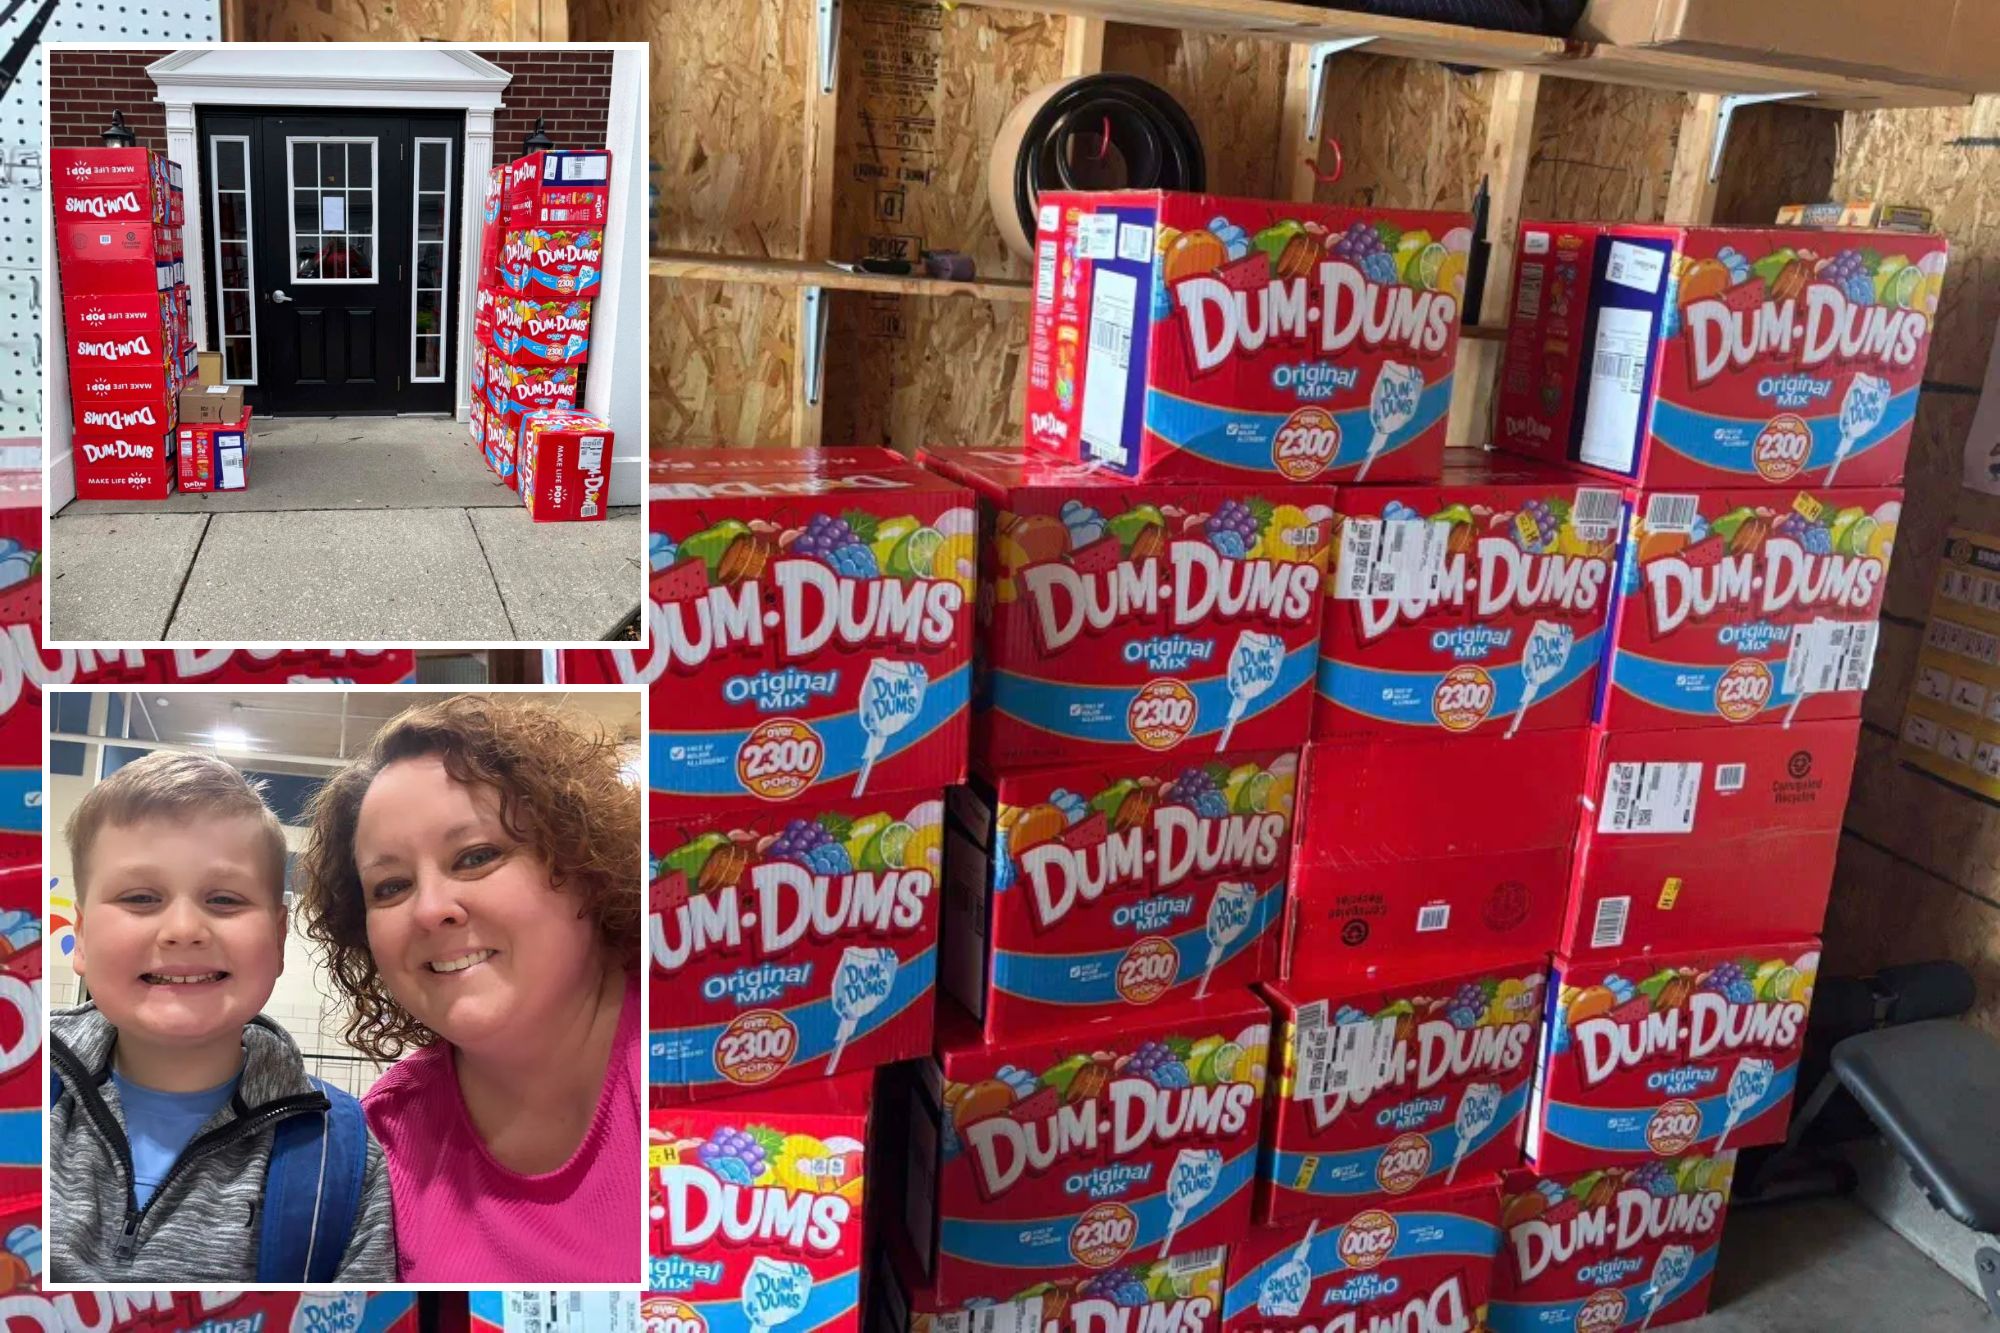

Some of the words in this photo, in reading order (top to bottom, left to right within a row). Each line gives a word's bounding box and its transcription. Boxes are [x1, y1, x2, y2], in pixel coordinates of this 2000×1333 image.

[1272, 362, 1358, 388] Original
[1757, 374, 1832, 400] Original
[1297, 383, 1333, 397] MIX
[1777, 393, 1808, 407] MIX
[1279, 427, 1334, 458] 2300
[1759, 433, 1808, 461] 2300
[556, 445, 565, 467] MAKE
[555, 468, 563, 483] LIFE
[1433, 626, 1512, 649] Original
[1718, 621, 1791, 645] Original
[1738, 638, 1769, 652] MIX
[1124, 637, 1214, 661] Original
[1455, 644, 1488, 657] MIX
[1151, 655, 1187, 670] MIX
[725, 670, 837, 701] Original
[873, 673, 915, 699] DUM-
[1439, 684, 1491, 711] 2300
[1721, 677, 1768, 701] 2300
[760, 692, 806, 709] MIX
[873, 692, 918, 720] DUMS
[1132, 699, 1192, 728] 2300
[767, 726, 793, 738] over
[743, 740, 817, 778] 2300
[761, 775, 801, 790] POPS
[1113, 896, 1193, 926] Original
[1137, 916, 1171, 931] MIX
[704, 964, 812, 998] Original
[844, 964, 886, 986] DUM-
[1122, 954, 1175, 986] 2300
[737, 987, 780, 1003] MIX
[845, 977, 888, 1002] DUMS
[719, 1028, 791, 1066] 2300
[1648, 1067, 1719, 1091] Original
[1376, 1096, 1447, 1126] Original
[1651, 1115, 1698, 1140] 2300
[1382, 1149, 1428, 1178] 2300
[1065, 1162, 1152, 1192] Original
[1090, 1181, 1128, 1198] MIX
[1075, 1218, 1133, 1251] 2300
[1343, 1227, 1392, 1254] 2300
[1578, 1256, 1643, 1282] Original
[755, 1271, 799, 1293] DUM-
[1323, 1274, 1400, 1306] Original
[652, 1304, 678, 1315] over
[755, 1290, 801, 1311] DUMS
[1581, 1301, 1623, 1327] 2300
